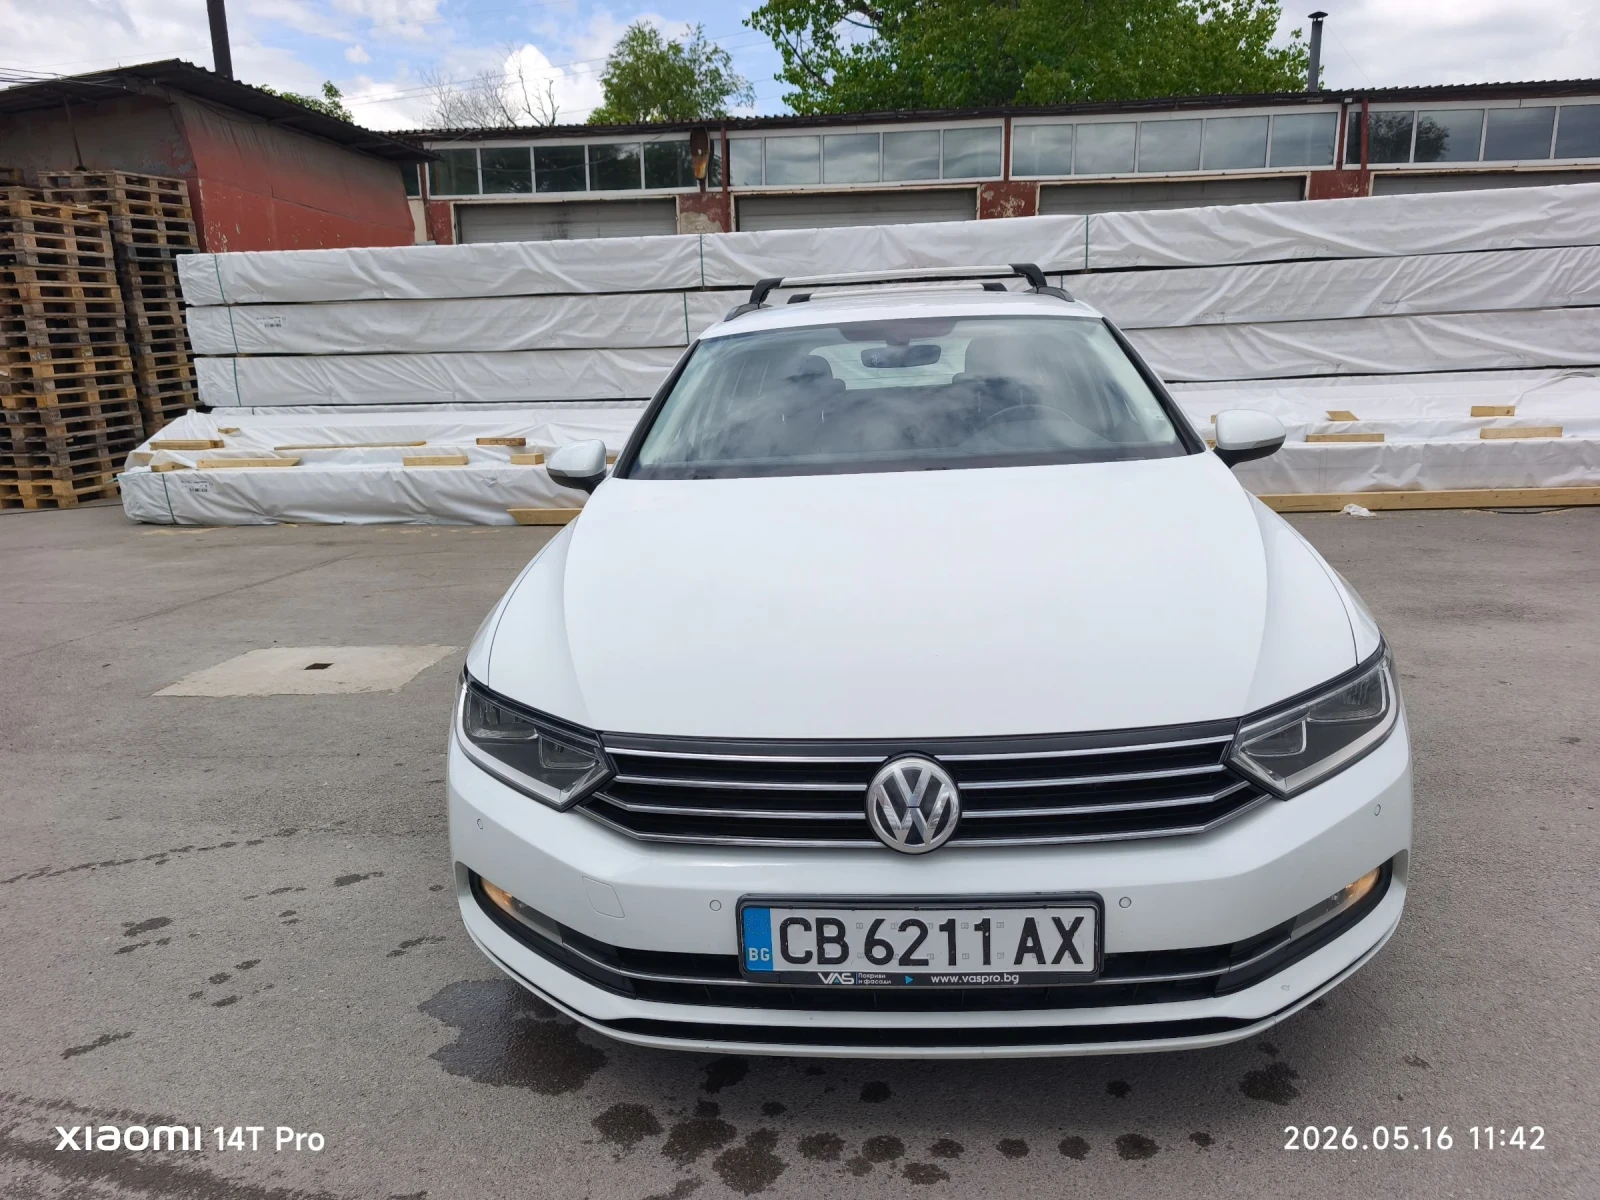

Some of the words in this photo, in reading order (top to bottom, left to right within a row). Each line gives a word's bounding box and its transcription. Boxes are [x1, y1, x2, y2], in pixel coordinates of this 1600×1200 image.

[779, 916, 850, 965] CB
[864, 917, 992, 966] 6211
[1013, 916, 1085, 966] AX
[748, 947, 770, 962] BG
[817, 972, 855, 985] VAS
[930, 973, 1020, 985] www.vaspro.bg
